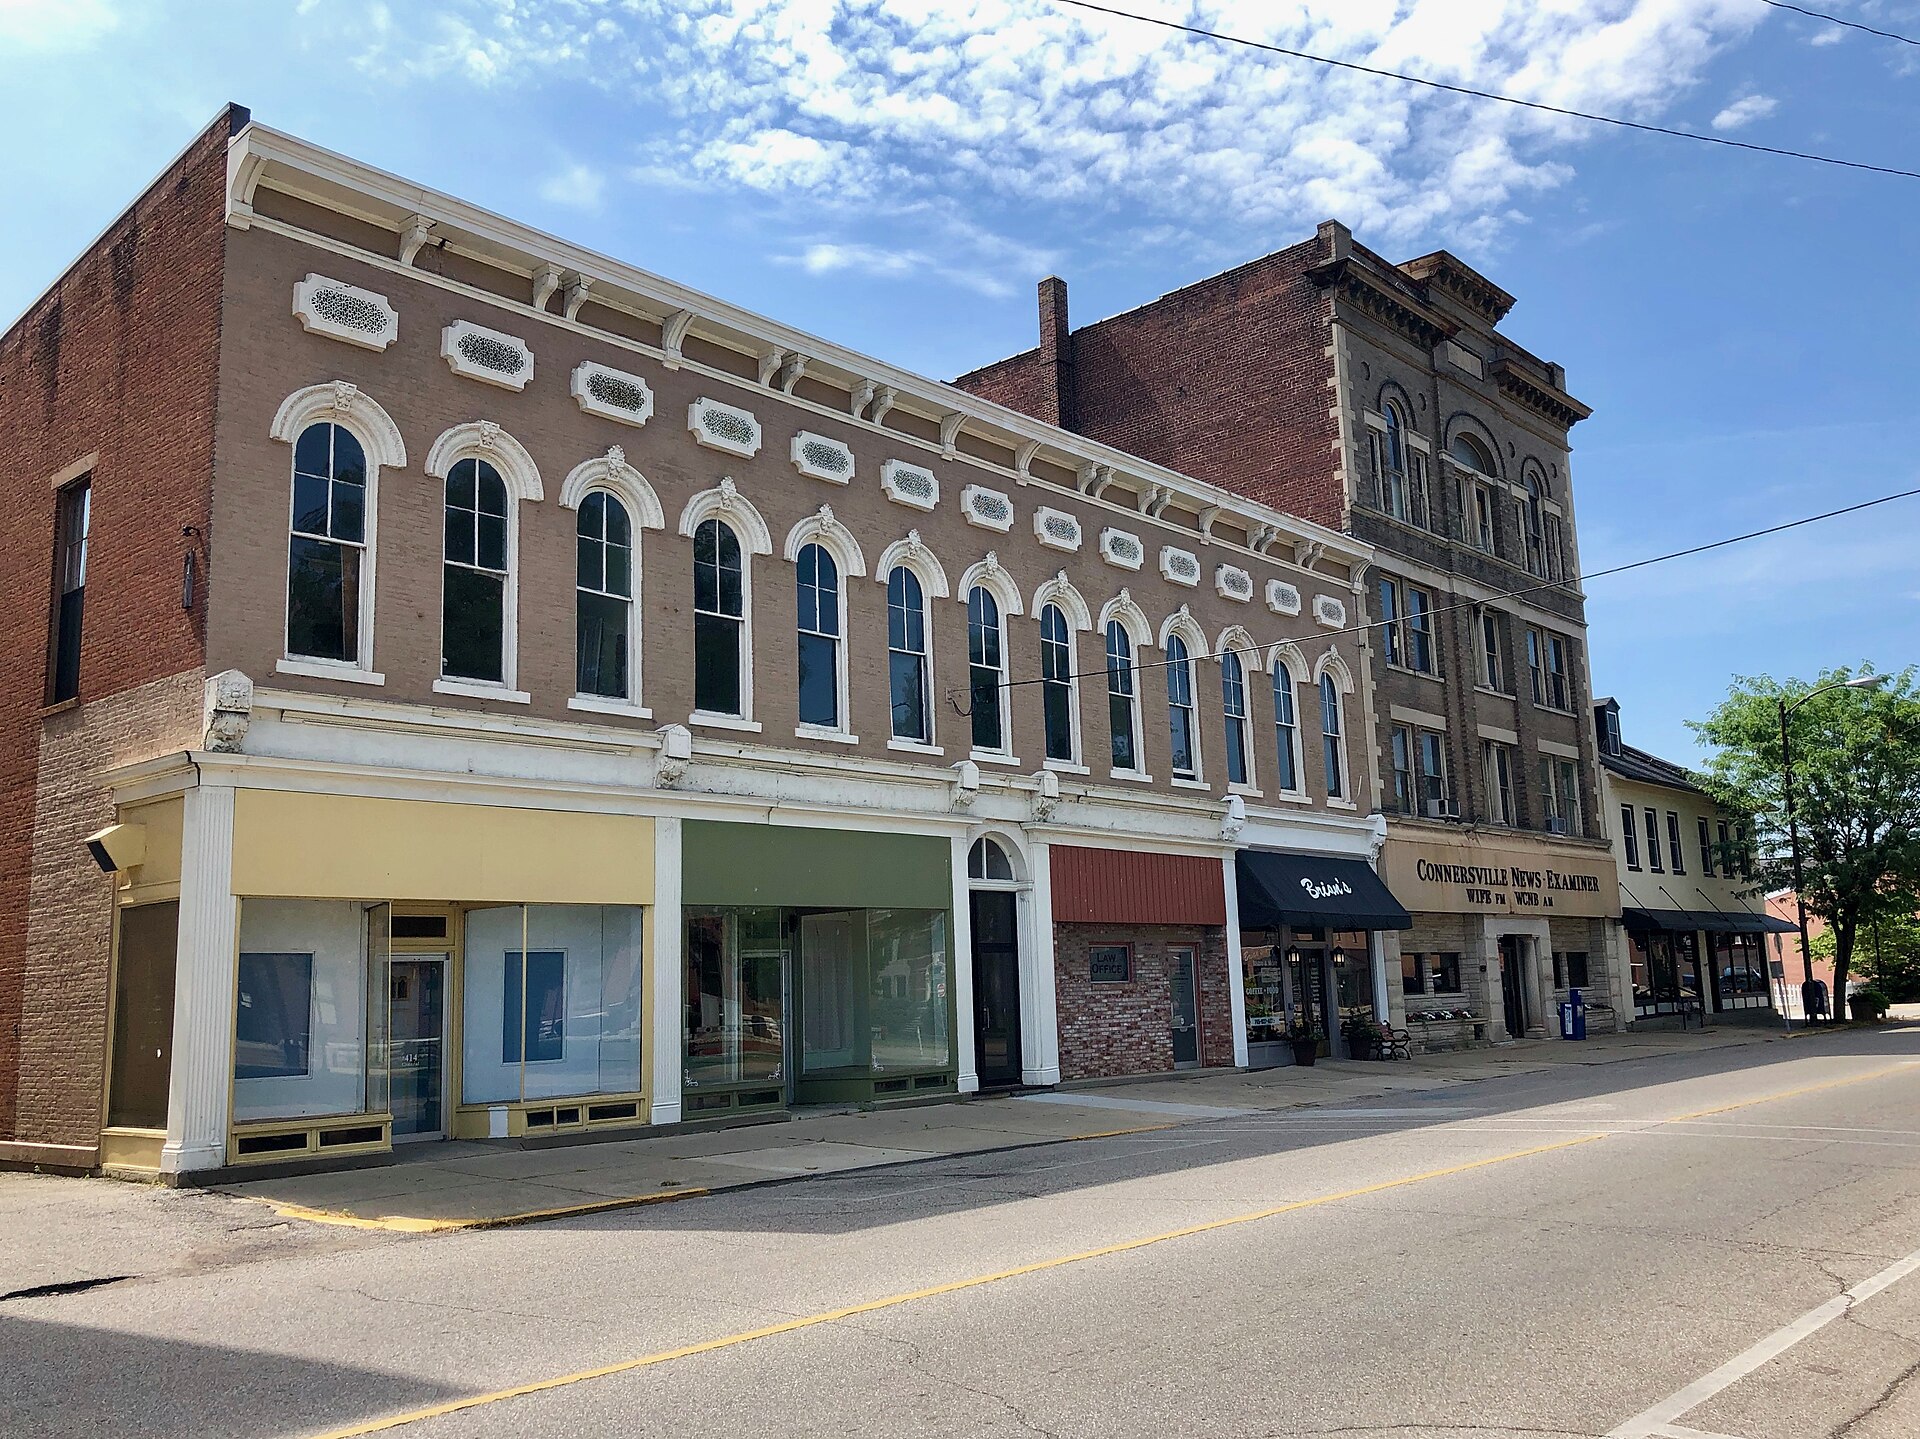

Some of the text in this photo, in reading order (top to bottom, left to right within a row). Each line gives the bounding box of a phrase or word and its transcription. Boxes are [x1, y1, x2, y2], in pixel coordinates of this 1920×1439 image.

[1416, 858, 1508, 886] CONNERSVILLE
[1300, 876, 1351, 899] Brian's
[1097, 953, 1117, 963] LAW
[1091, 963, 1123, 974] OFFICE
